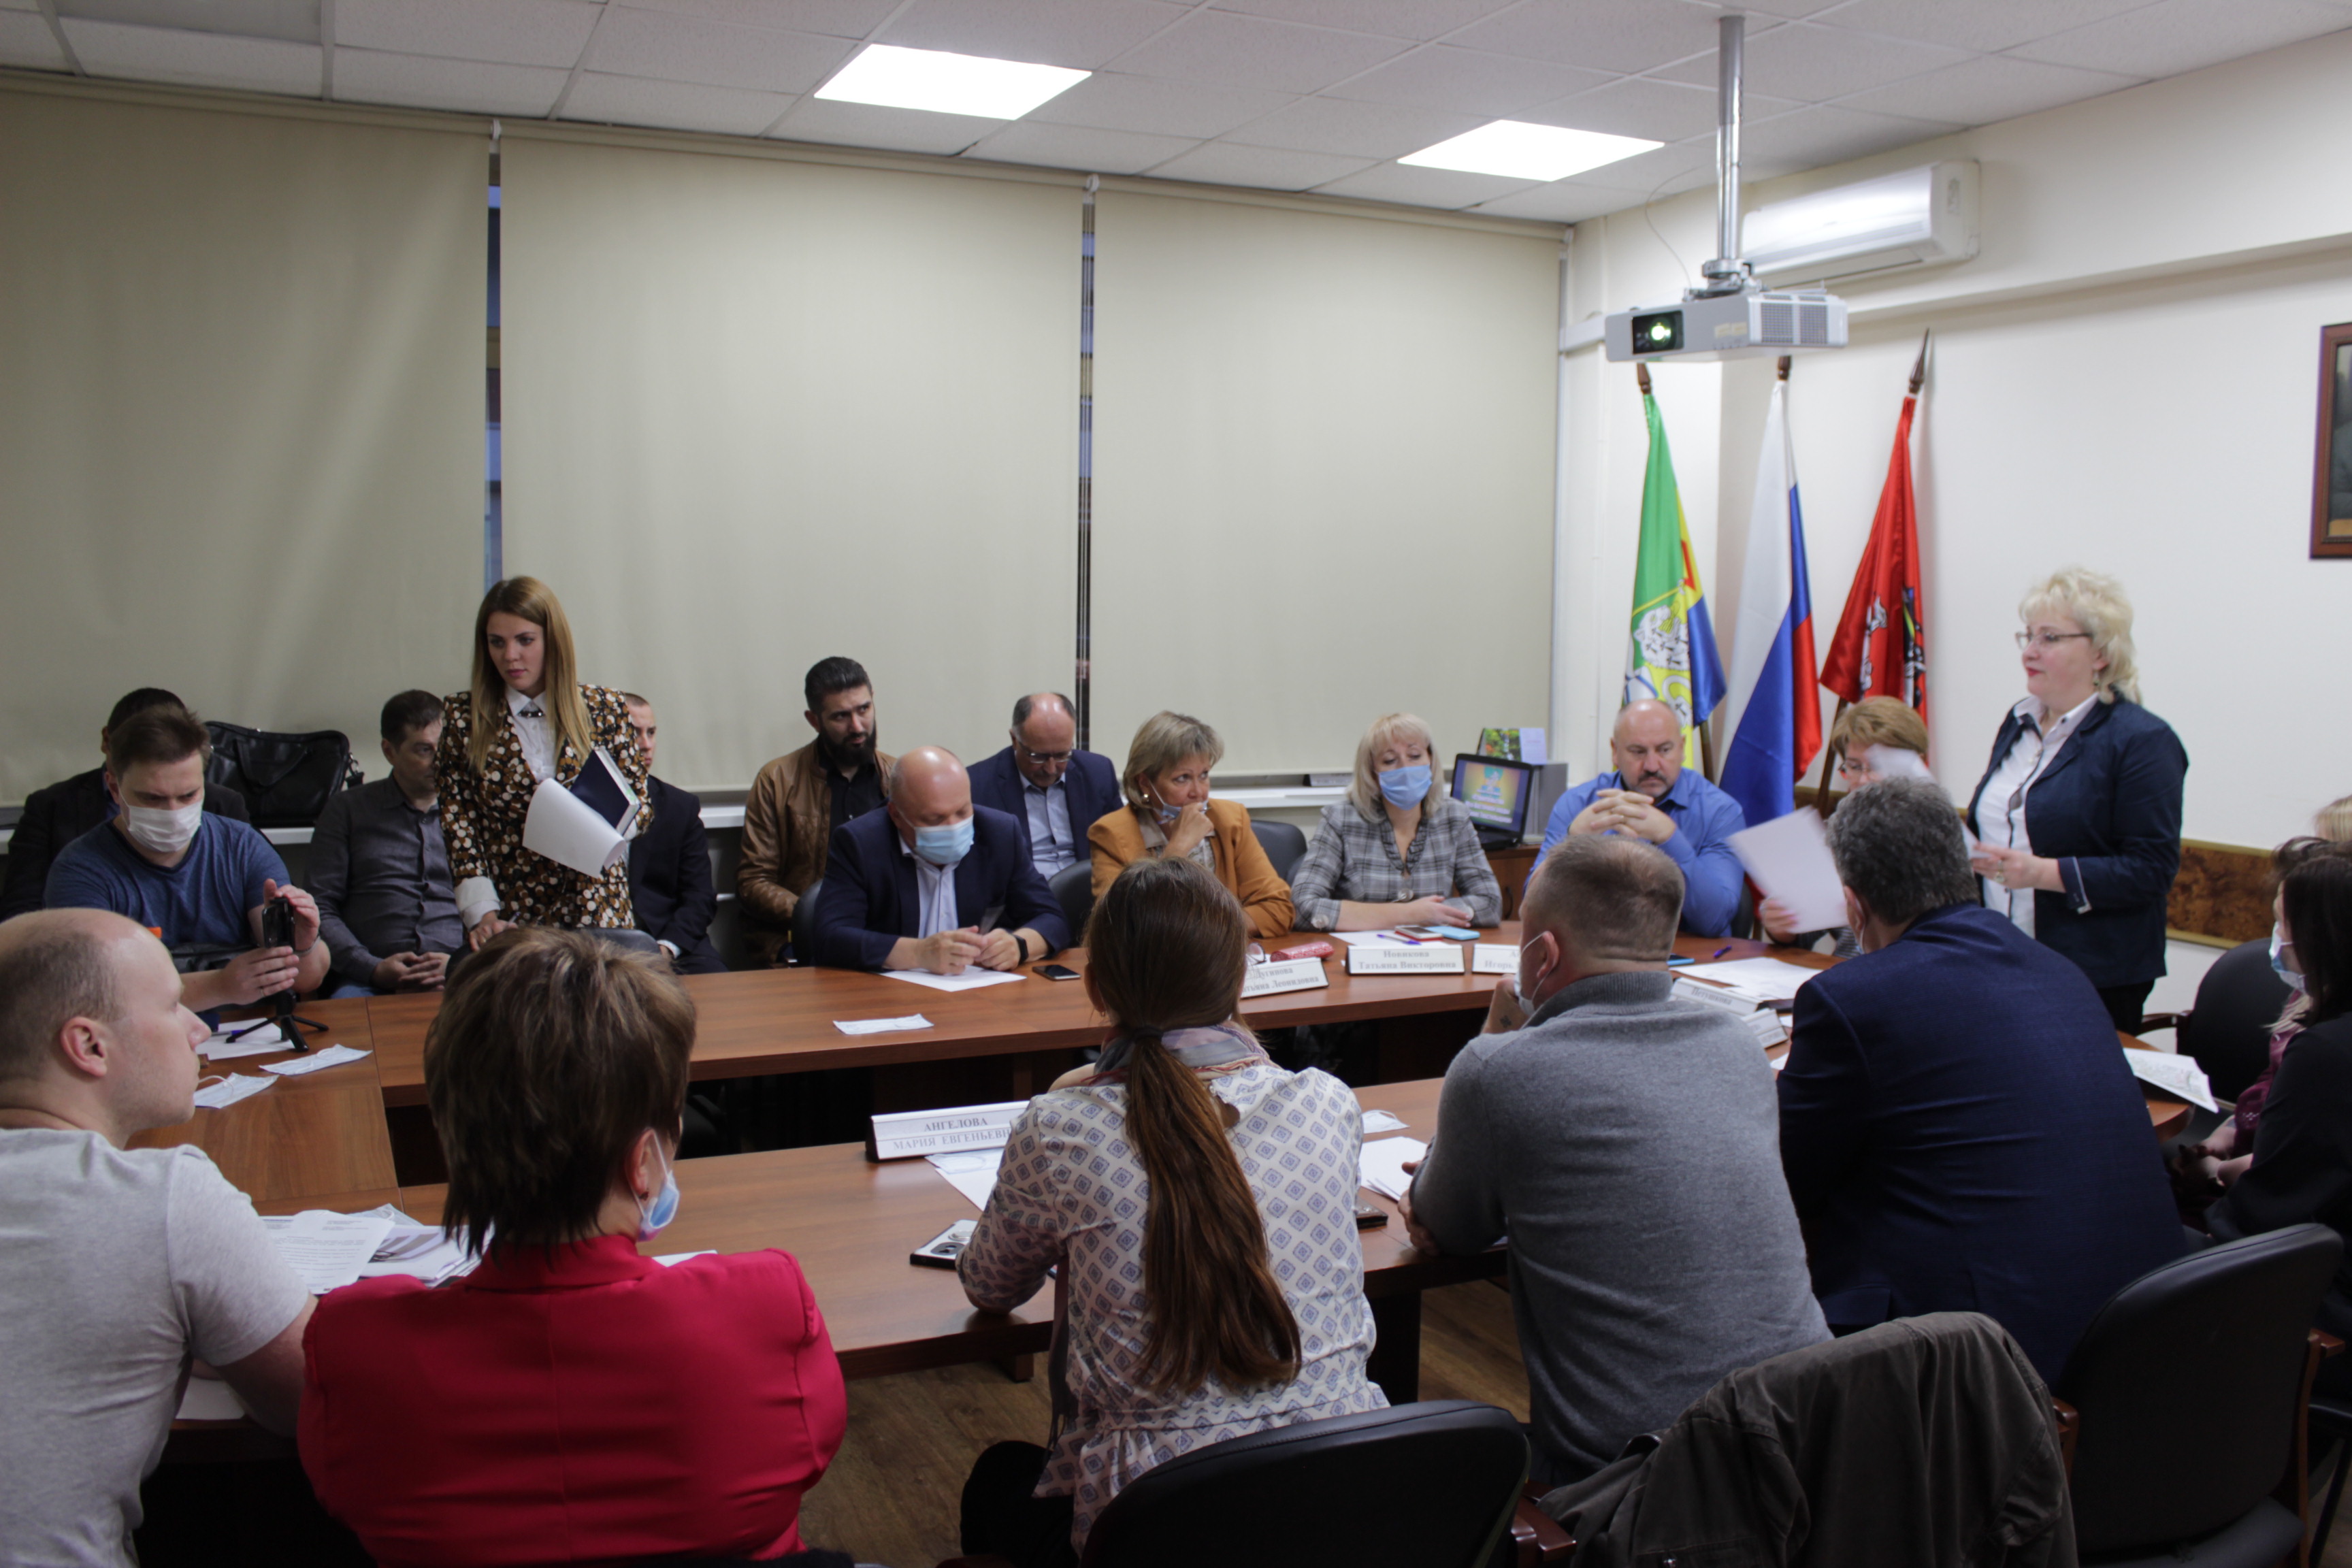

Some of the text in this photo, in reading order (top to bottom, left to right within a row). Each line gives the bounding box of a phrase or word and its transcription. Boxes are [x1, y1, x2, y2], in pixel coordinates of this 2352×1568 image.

[1383, 950, 1429, 958] Новикова
[1358, 960, 1456, 970] Татьяна Викторовна
[1243, 976, 1319, 994] атьяна Леонидовна
[924, 1117, 987, 1132] АНГЕЛОВА
[893, 1128, 1010, 1151] МАРИЯ ЕВГЕНЬЕВН
